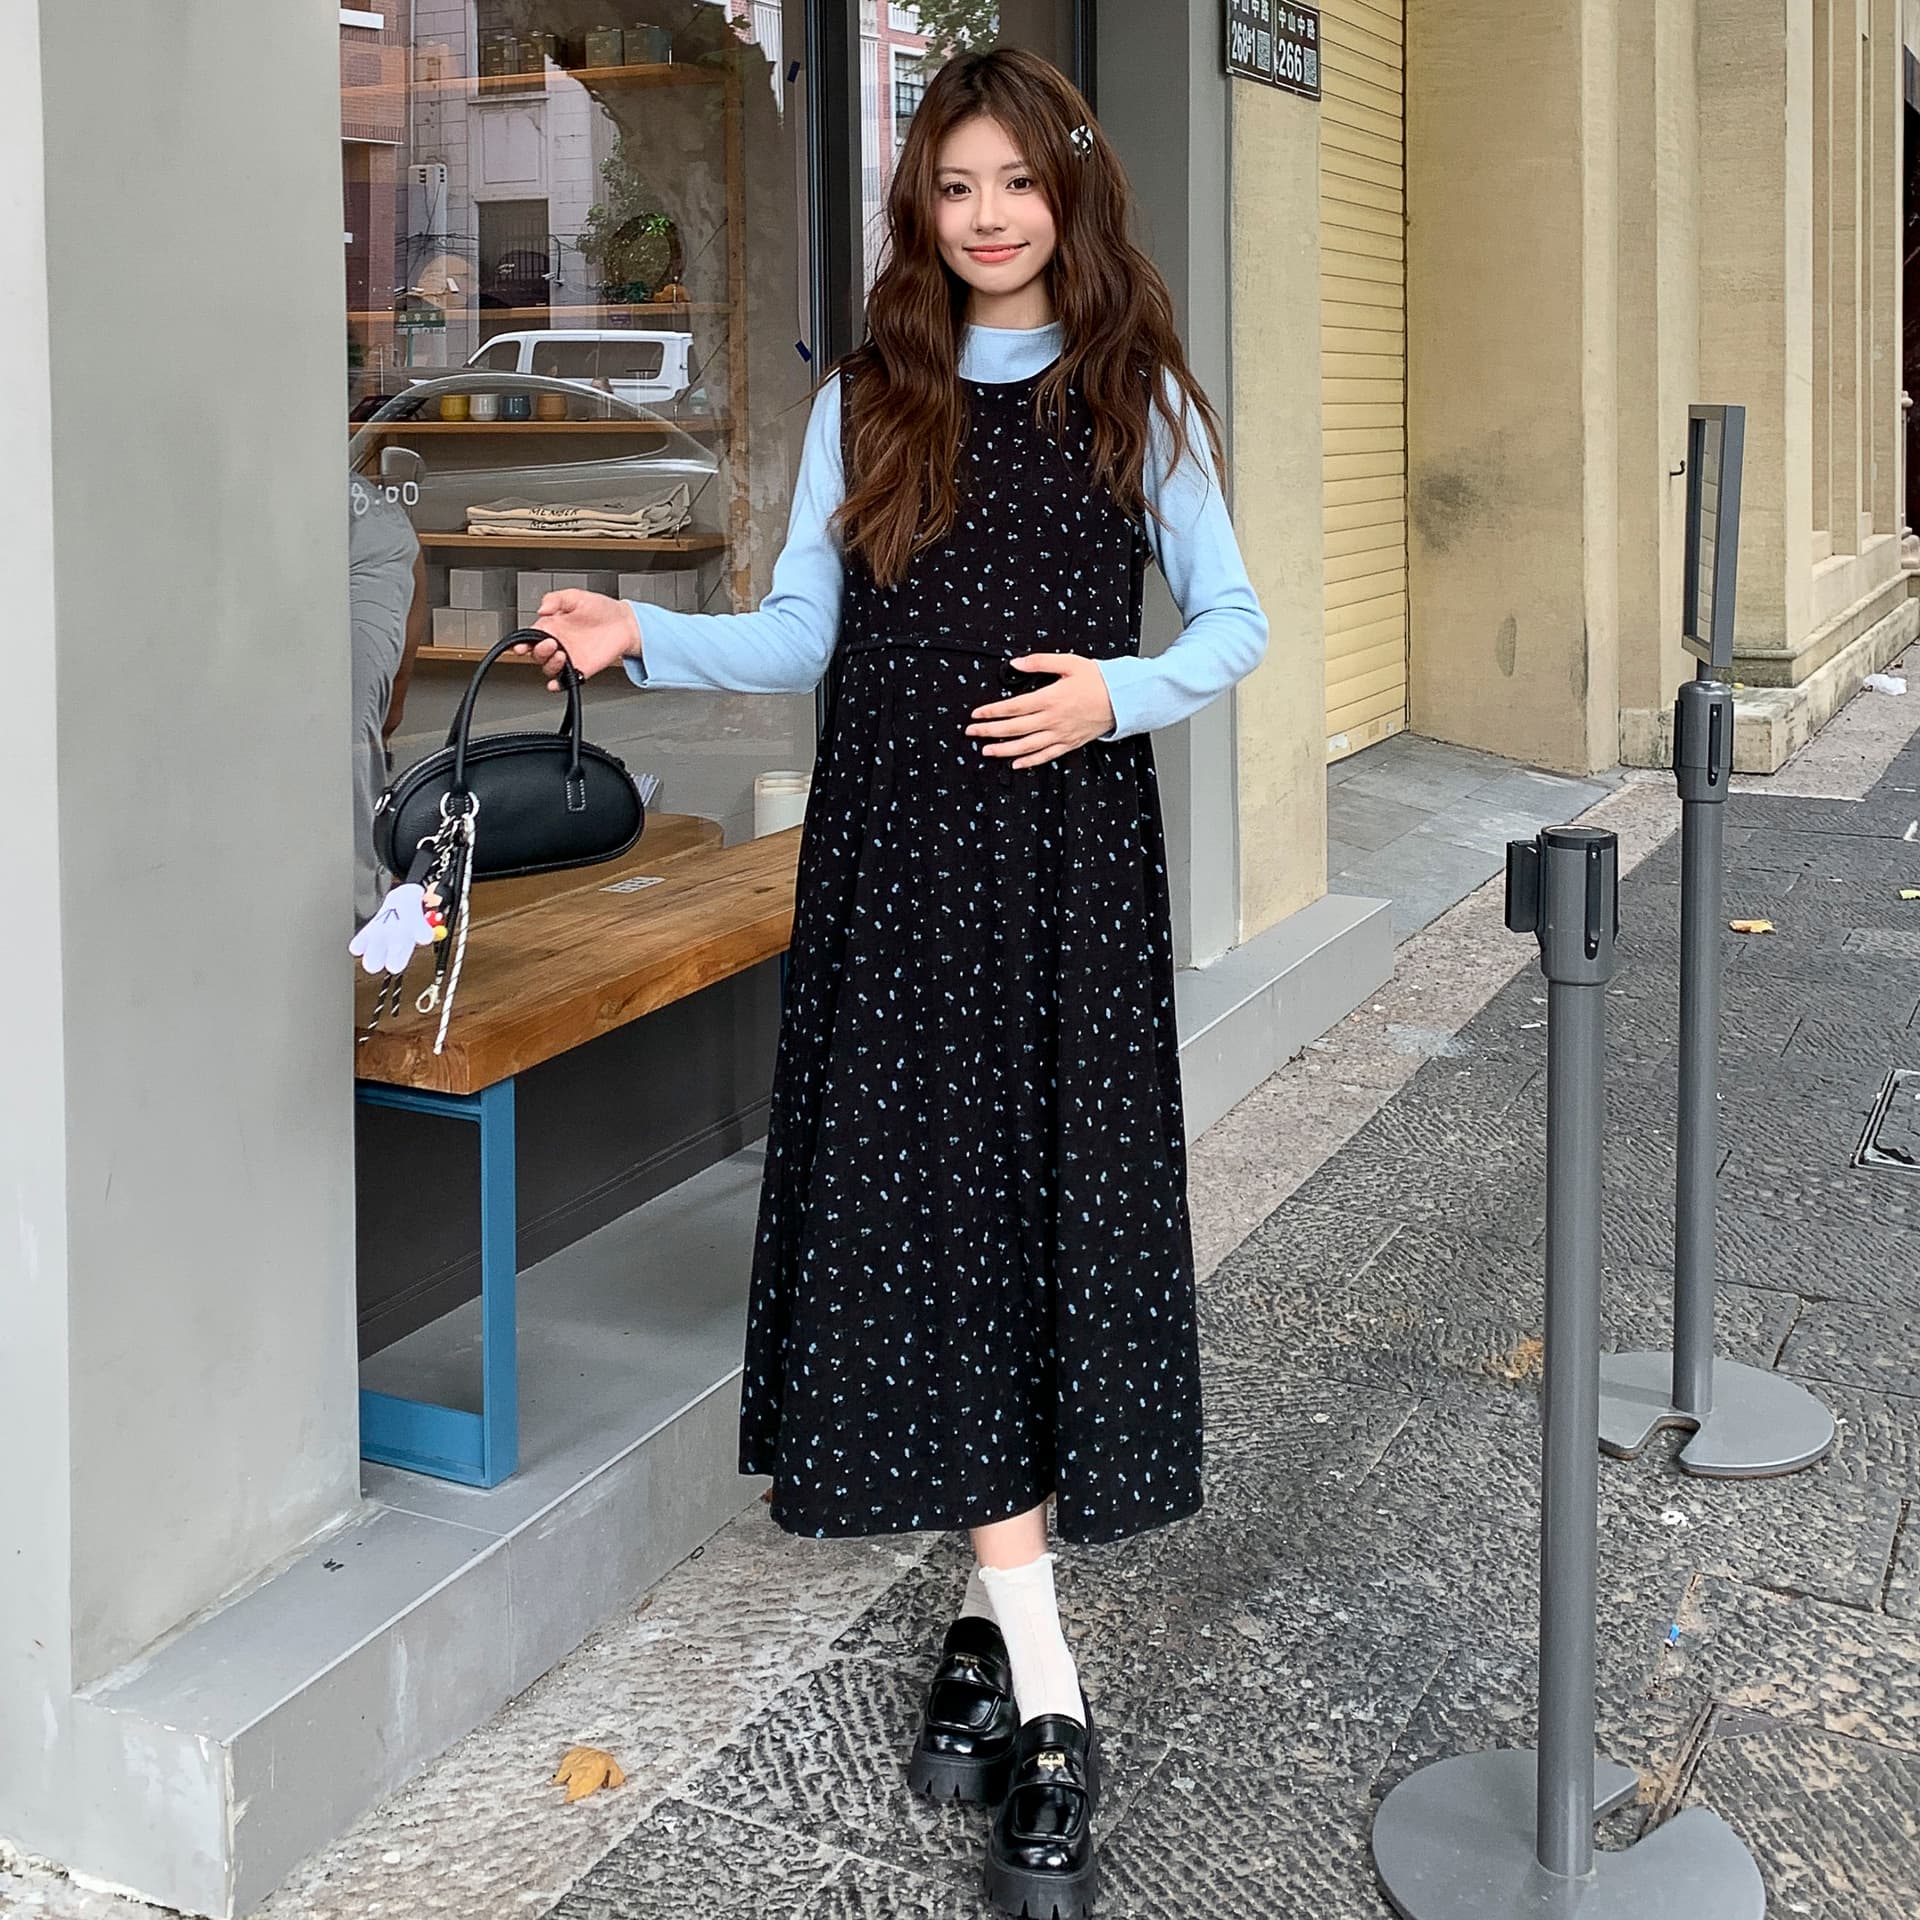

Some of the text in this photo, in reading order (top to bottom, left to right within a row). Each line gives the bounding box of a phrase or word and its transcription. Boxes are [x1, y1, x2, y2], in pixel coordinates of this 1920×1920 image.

[1278, 7, 1315, 40] 中山中路
[1278, 38, 1302, 81] 266
